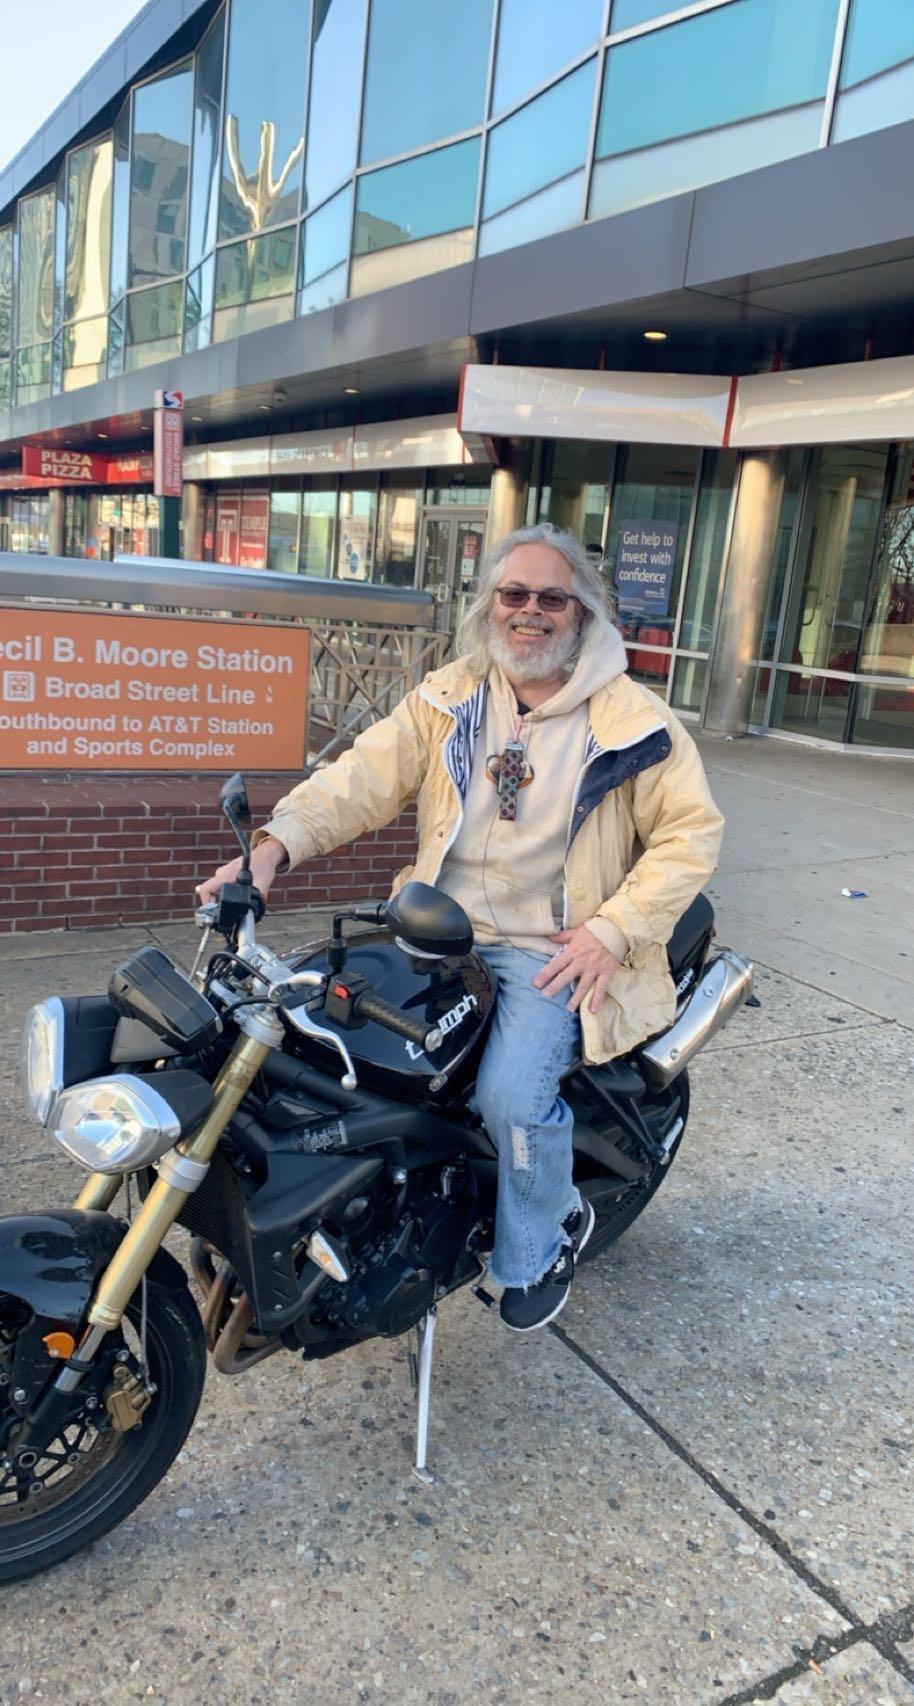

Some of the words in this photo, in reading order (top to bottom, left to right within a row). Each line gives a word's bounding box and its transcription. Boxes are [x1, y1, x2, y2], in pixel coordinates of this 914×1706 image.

[41, 450, 93, 467] PLAZA
[41, 463, 92, 480] PIZZA
[623, 531, 639, 545] Get
[640, 531, 661, 548] help
[663, 534, 674, 546] to
[621, 549, 648, 564] invest
[650, 551, 671, 565] with
[619, 567, 666, 583] confidence
[0, 635, 42, 661] cil
[53, 636, 84, 662] B.
[95, 639, 188, 669] Moore
[196, 645, 293, 674] Station
[45, 676, 120, 700] Broad
[127, 680, 199, 703] Street
[207, 684, 256, 705] Line
[0, 712, 116, 732] outhbound
[122, 716, 143, 733] to
[148, 716, 202, 734] AT&T
[207, 718, 274, 735] Station
[27, 738, 67, 755] and
[74, 739, 143, 759] Sports
[149, 739, 235, 760] Complex
